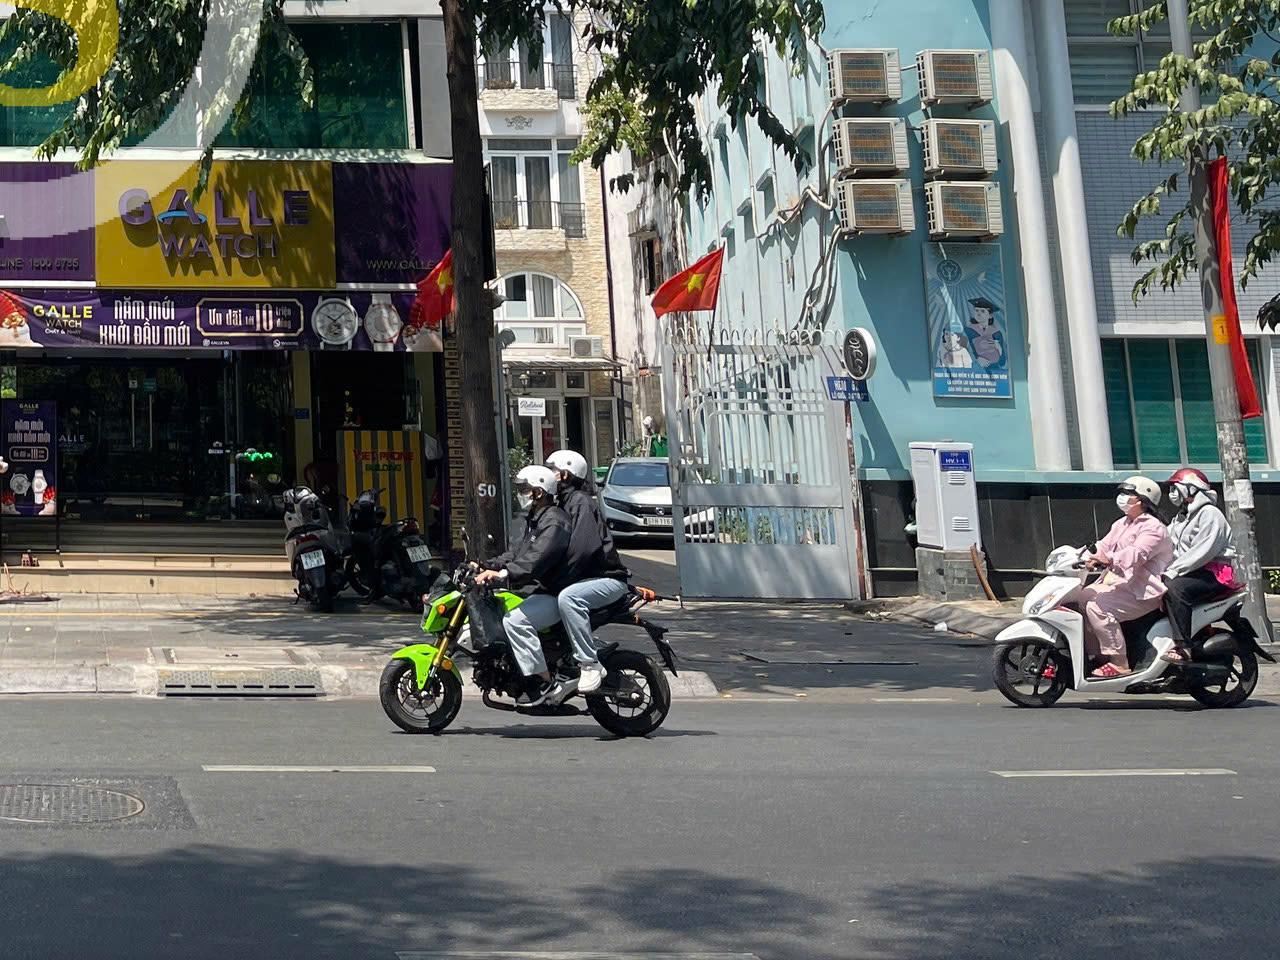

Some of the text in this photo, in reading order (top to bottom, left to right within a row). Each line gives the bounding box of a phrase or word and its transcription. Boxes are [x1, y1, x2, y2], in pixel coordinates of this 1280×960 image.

[118, 188, 311, 226] GALLE
[158, 233, 277, 258] WATCH
[33, 304, 93, 319] GALLE
[255, 303, 274, 331] 10
[46, 319, 82, 329] WATCH
[478, 484, 496, 497] 50
